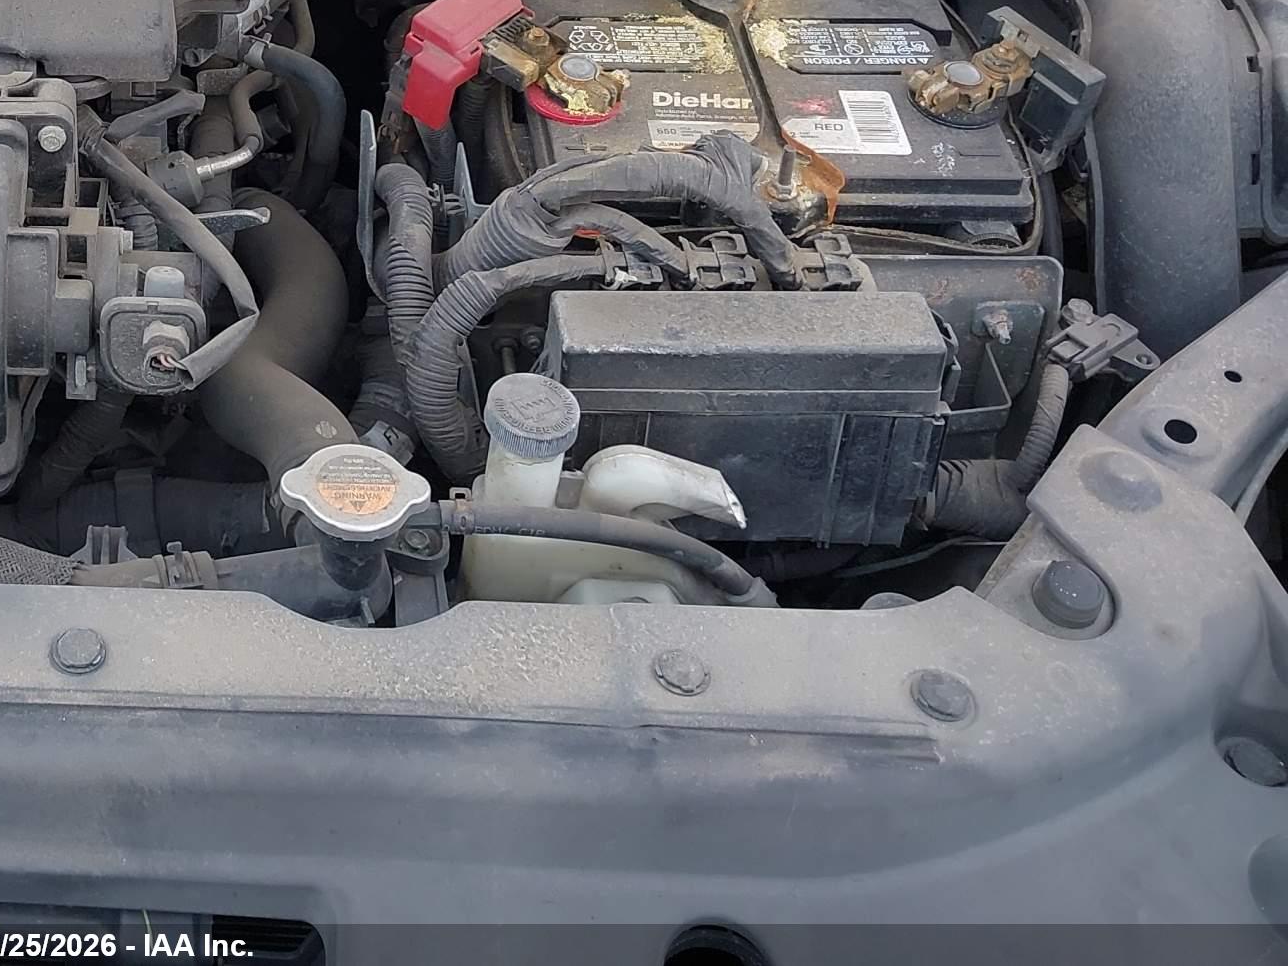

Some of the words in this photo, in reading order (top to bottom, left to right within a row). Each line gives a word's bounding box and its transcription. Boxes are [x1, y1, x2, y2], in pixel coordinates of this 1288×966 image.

[803, 57, 851, 65] POISON
[863, 57, 917, 65] DANGER
[652, 91, 754, 109] DieHar
[815, 123, 844, 131] RED
